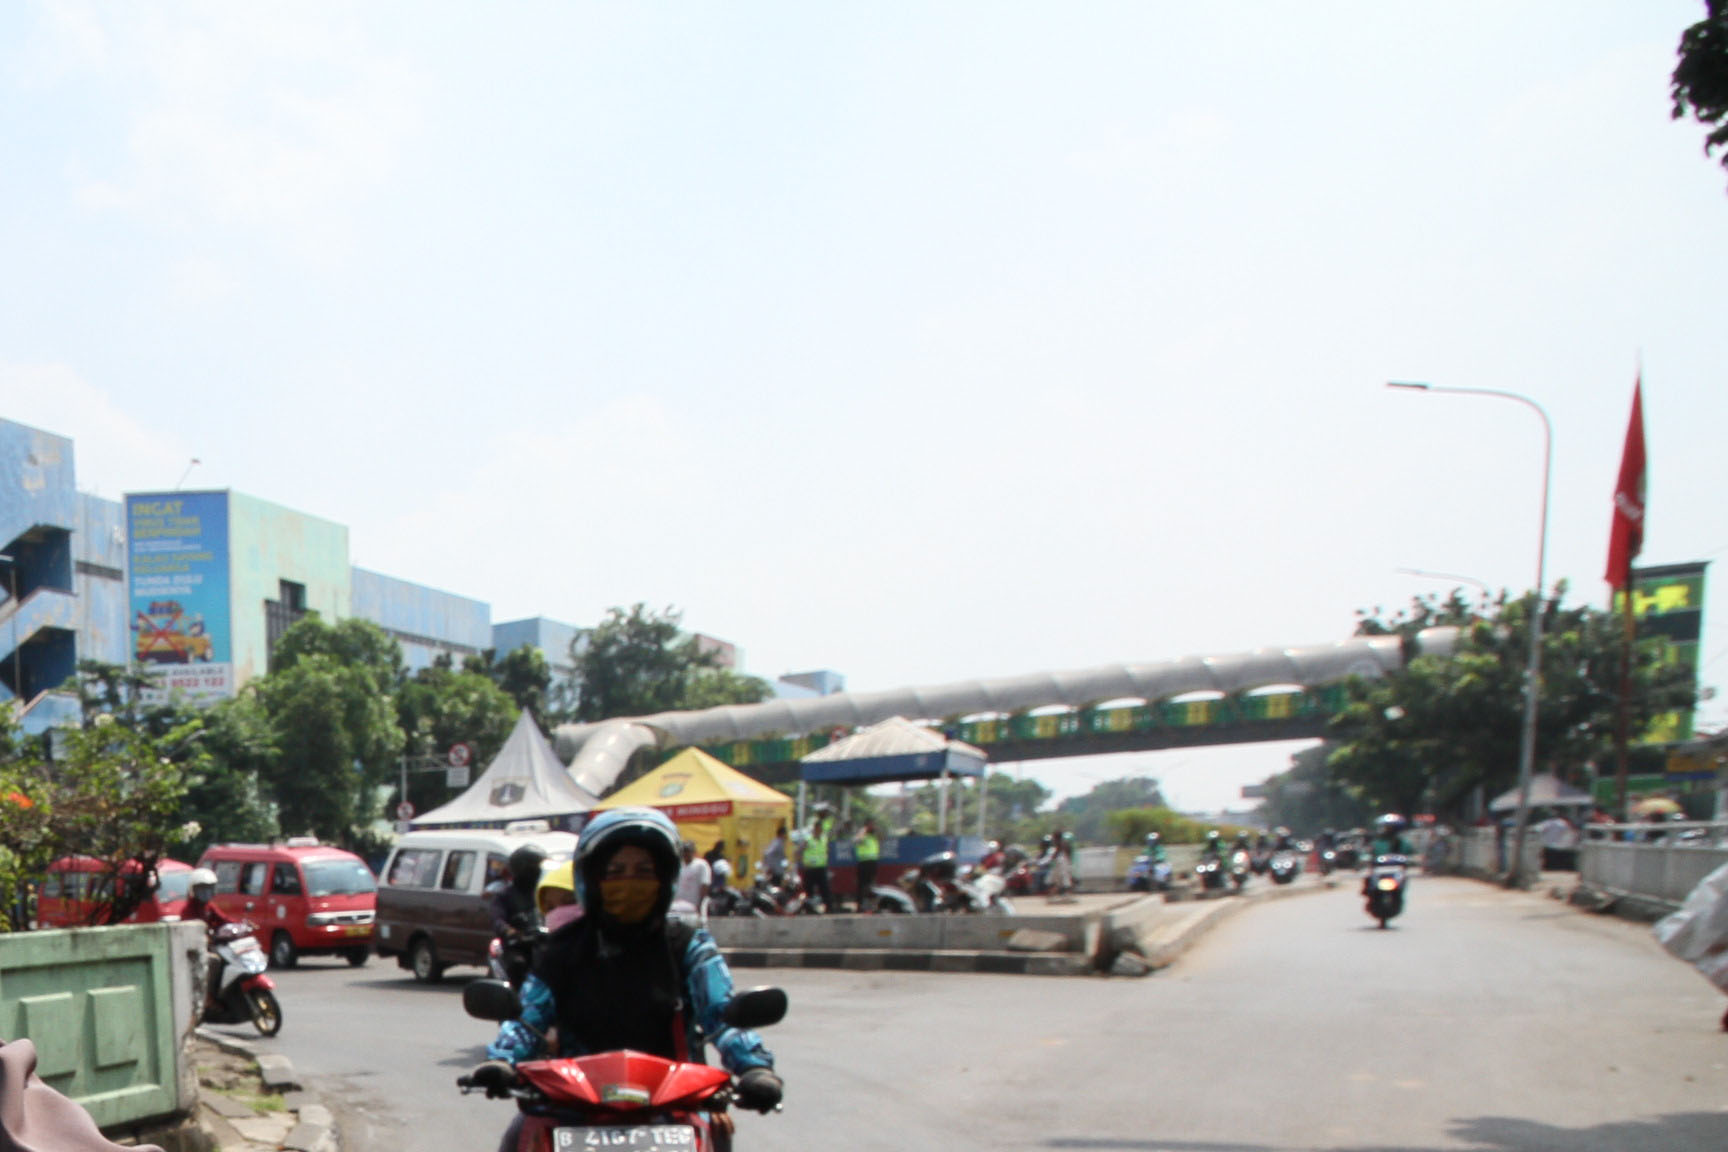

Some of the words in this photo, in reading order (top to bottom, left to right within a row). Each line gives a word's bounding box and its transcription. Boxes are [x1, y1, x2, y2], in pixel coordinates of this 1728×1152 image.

[132, 501, 184, 516] INGAT
[172, 667, 225, 677] AVAILABLE
[678, 803, 729, 817] MINGGU
[559, 1131, 573, 1147] B
